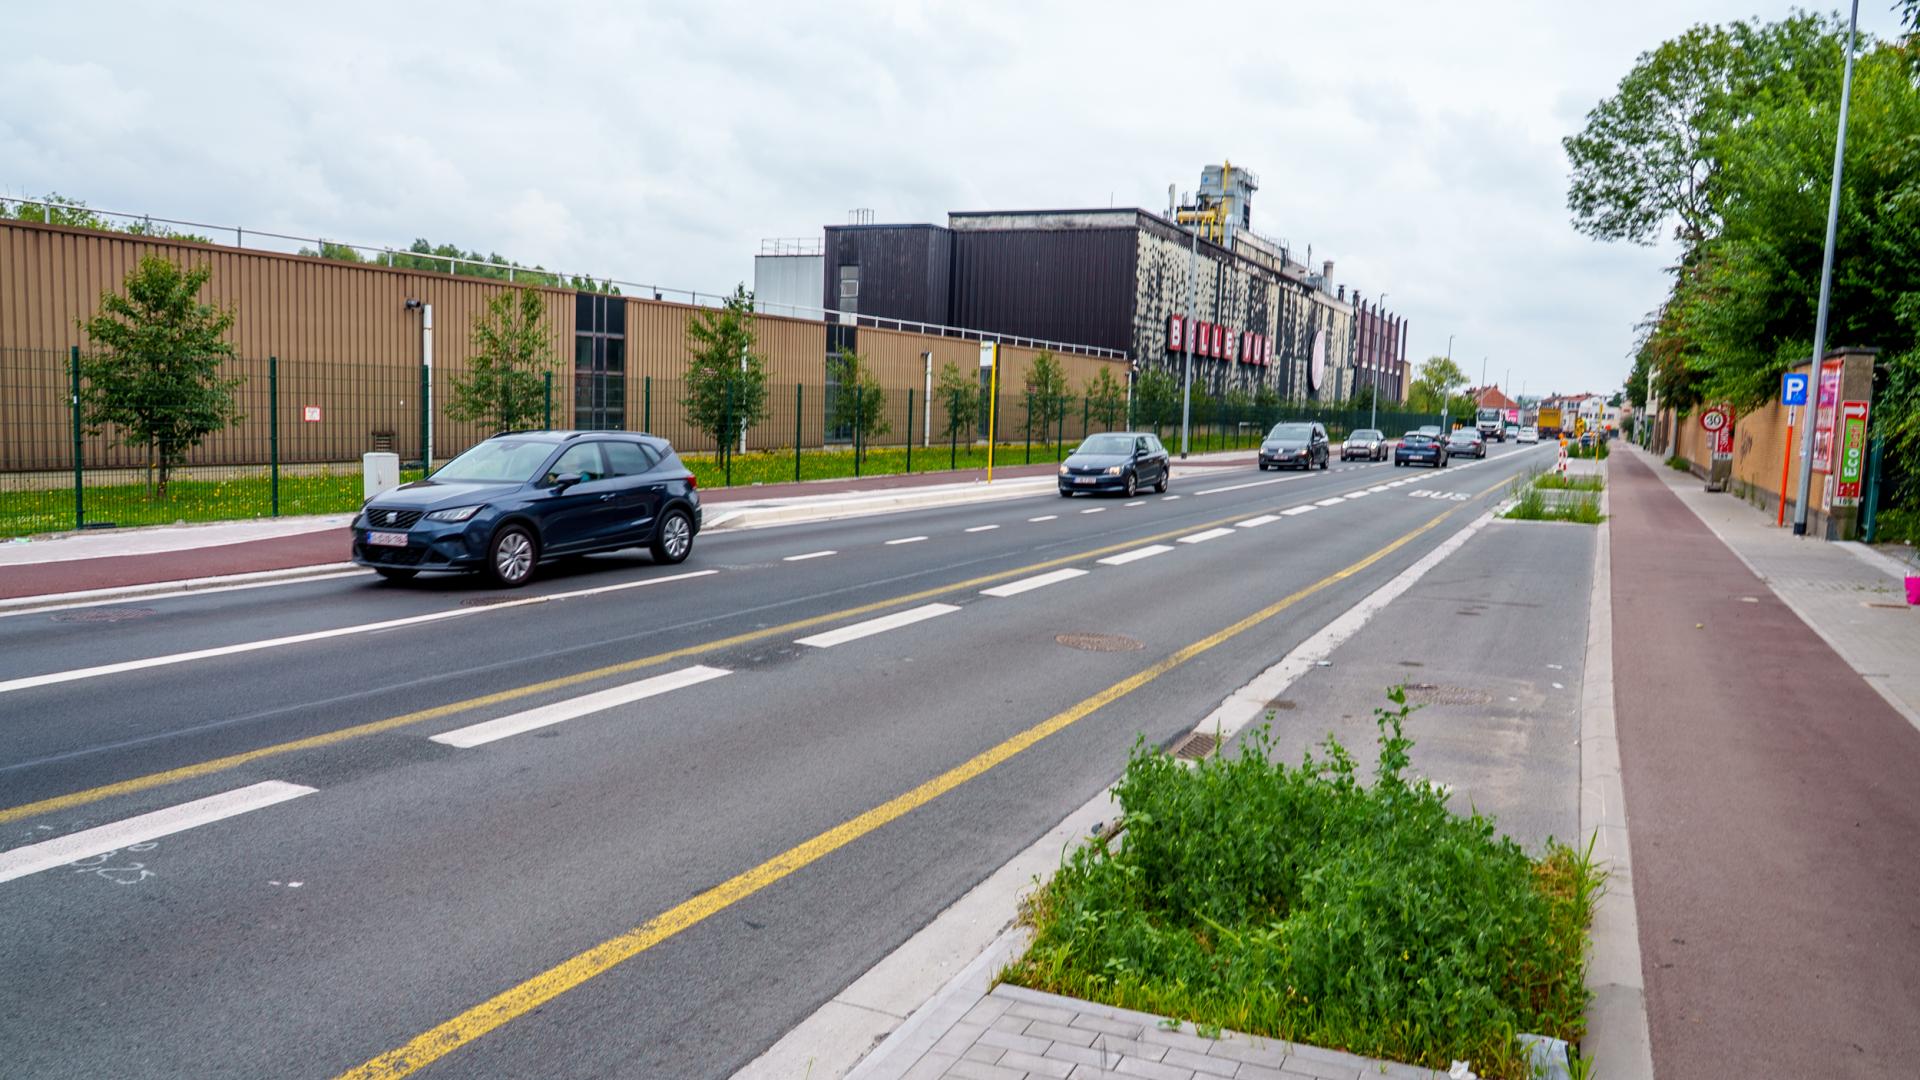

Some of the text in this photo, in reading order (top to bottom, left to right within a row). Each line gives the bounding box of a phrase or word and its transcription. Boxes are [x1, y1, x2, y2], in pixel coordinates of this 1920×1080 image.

[1243, 334, 1272, 365] VUE
[1786, 379, 1804, 401] P
[1706, 415, 1721, 426] 30
[1408, 489, 1471, 501] BUS
